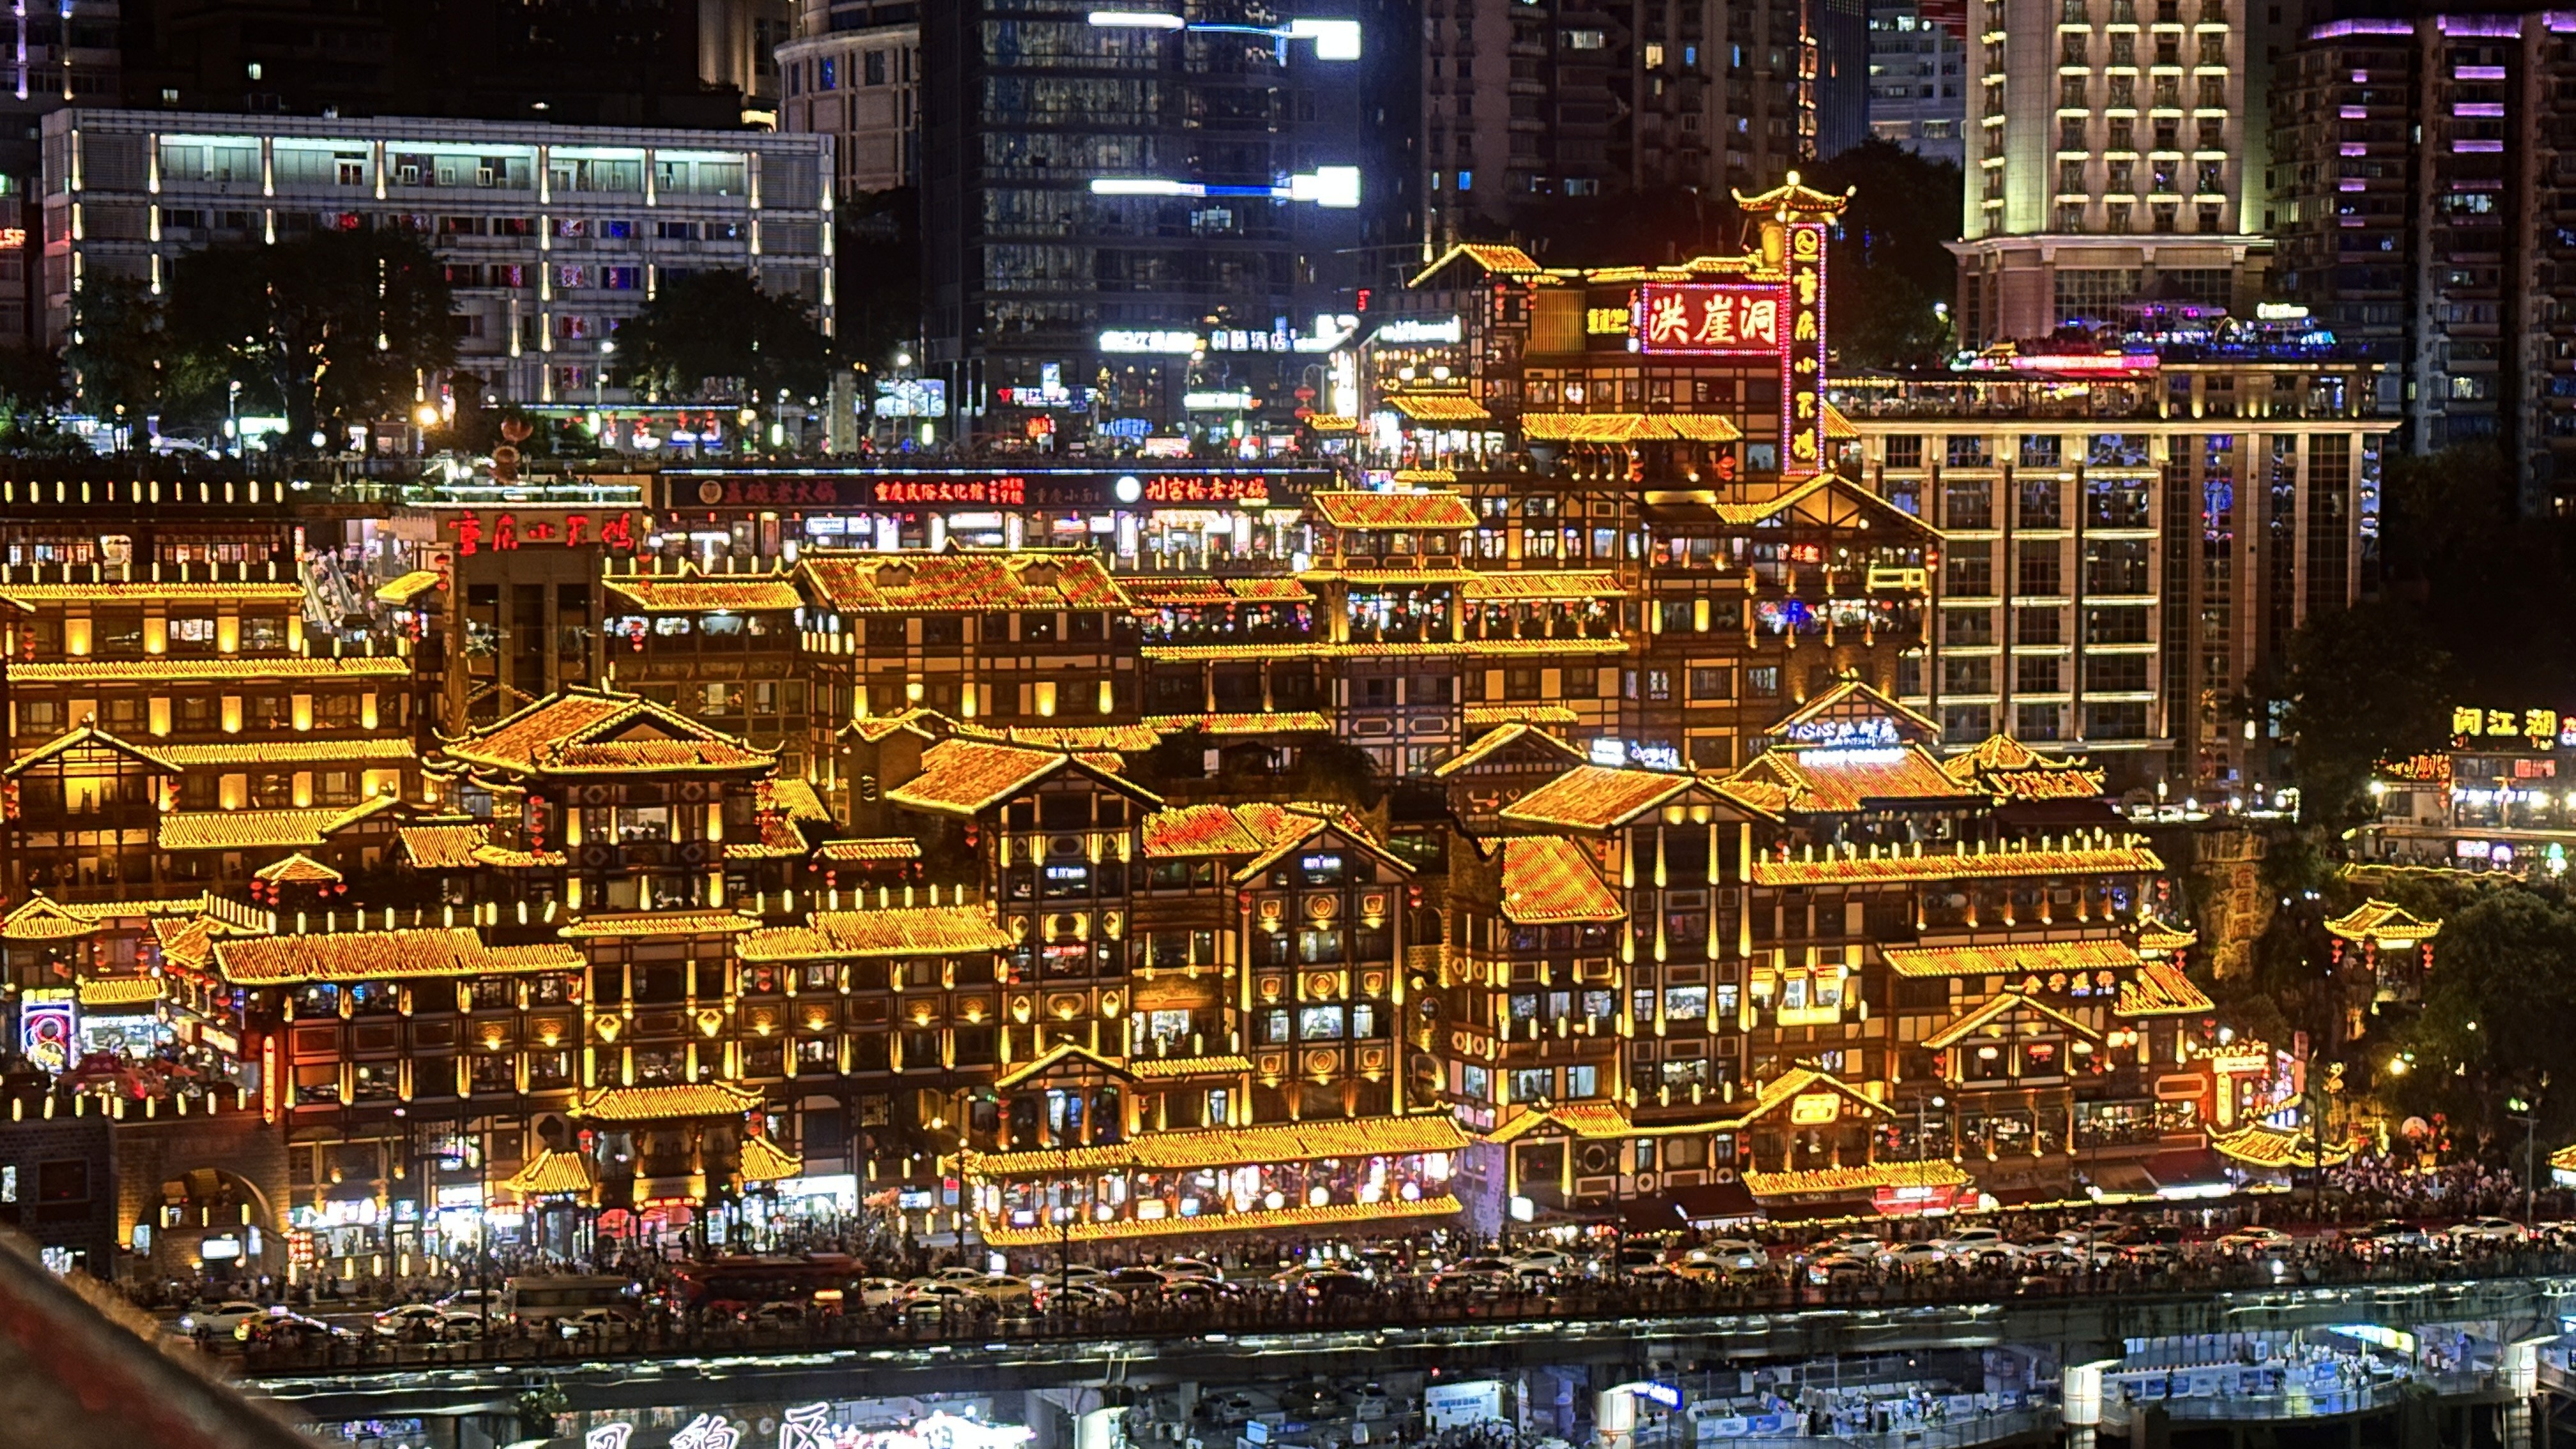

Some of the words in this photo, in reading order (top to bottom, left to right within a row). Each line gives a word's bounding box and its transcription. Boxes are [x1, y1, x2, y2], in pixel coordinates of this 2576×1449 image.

[1650, 292, 1777, 345] 洪崖洞
[1146, 475, 1268, 501] 九宫格老火锅
